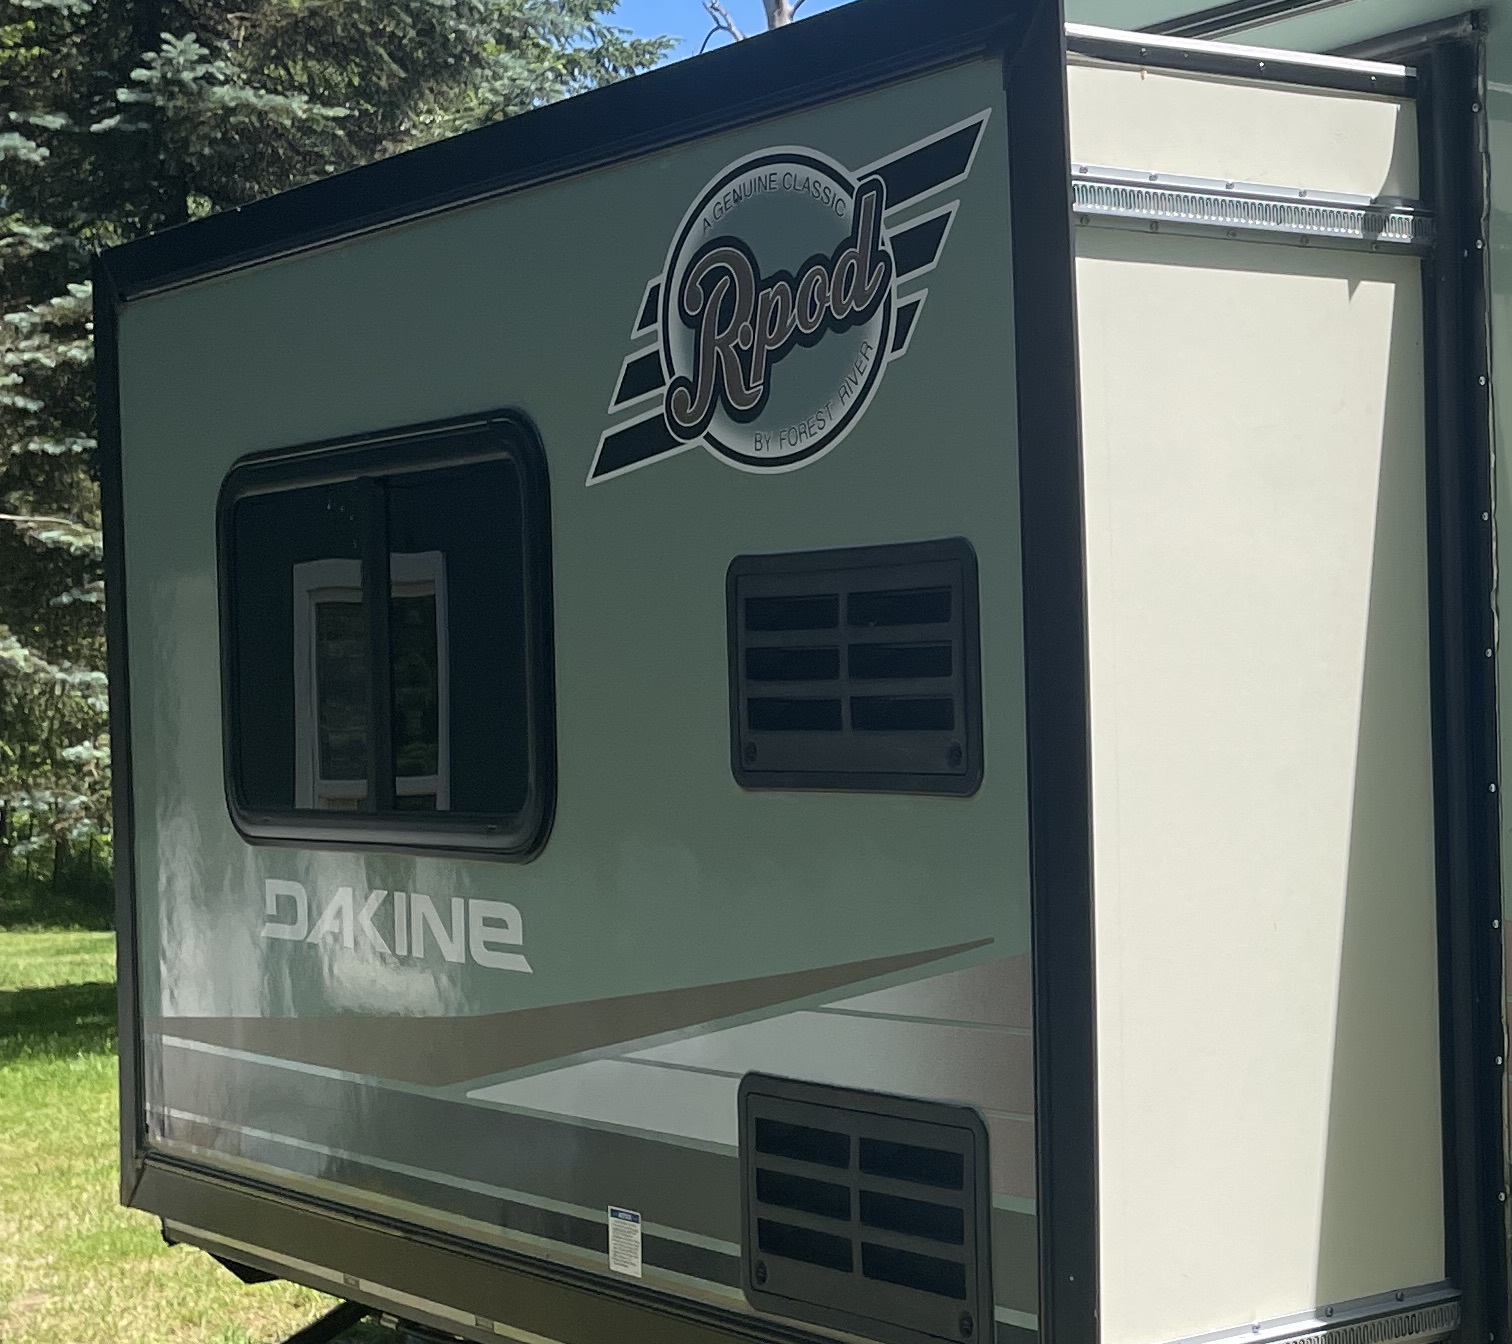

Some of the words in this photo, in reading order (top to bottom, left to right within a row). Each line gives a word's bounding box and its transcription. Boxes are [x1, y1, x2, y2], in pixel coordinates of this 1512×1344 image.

[702, 218, 713, 235] A
[713, 172, 779, 219] GENUINE
[782, 172, 848, 218] CLASSIC
[754, 432, 772, 452] BY
[779, 403, 835, 450] FOREST
[838, 341, 873, 406] RIVER
